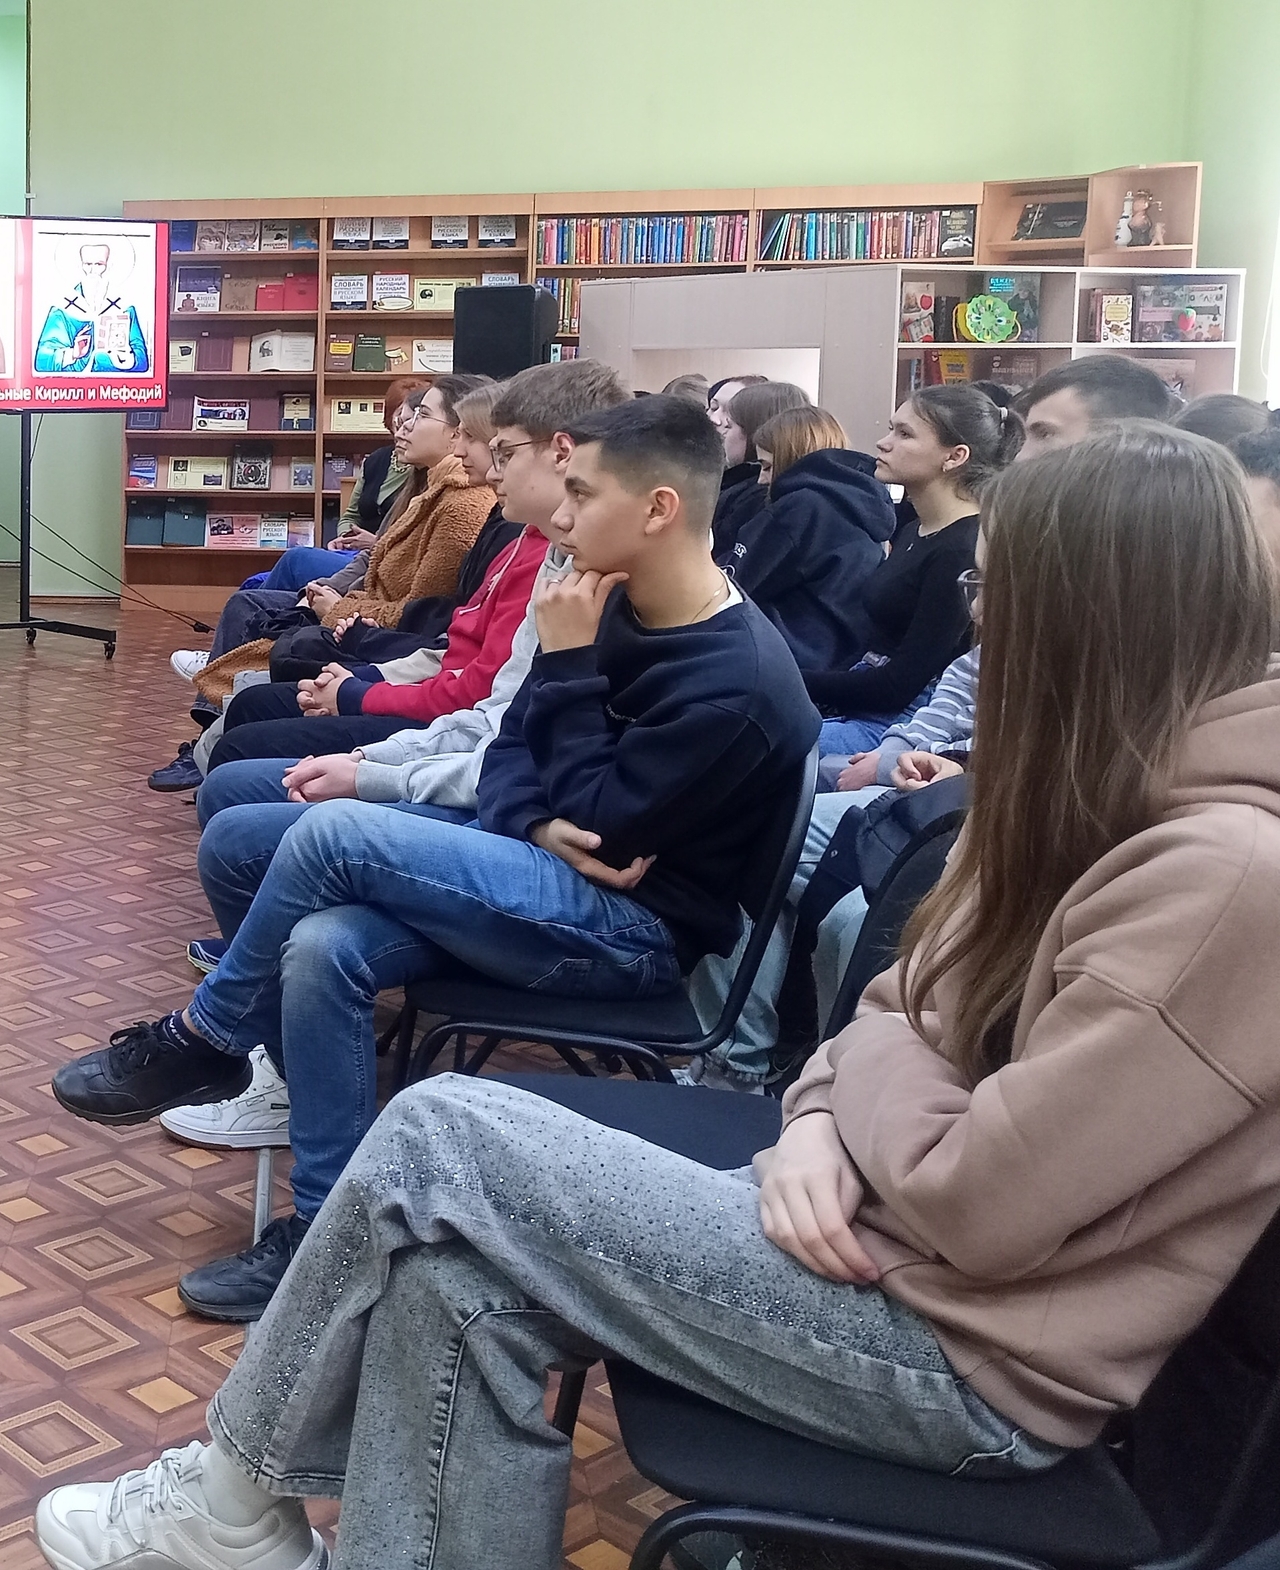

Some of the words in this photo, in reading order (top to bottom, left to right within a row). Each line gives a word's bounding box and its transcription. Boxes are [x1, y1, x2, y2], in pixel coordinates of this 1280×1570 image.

[34, 386, 84, 403] Кирилл
[87, 387, 96, 400] и
[99, 384, 163, 403] Мефодий
